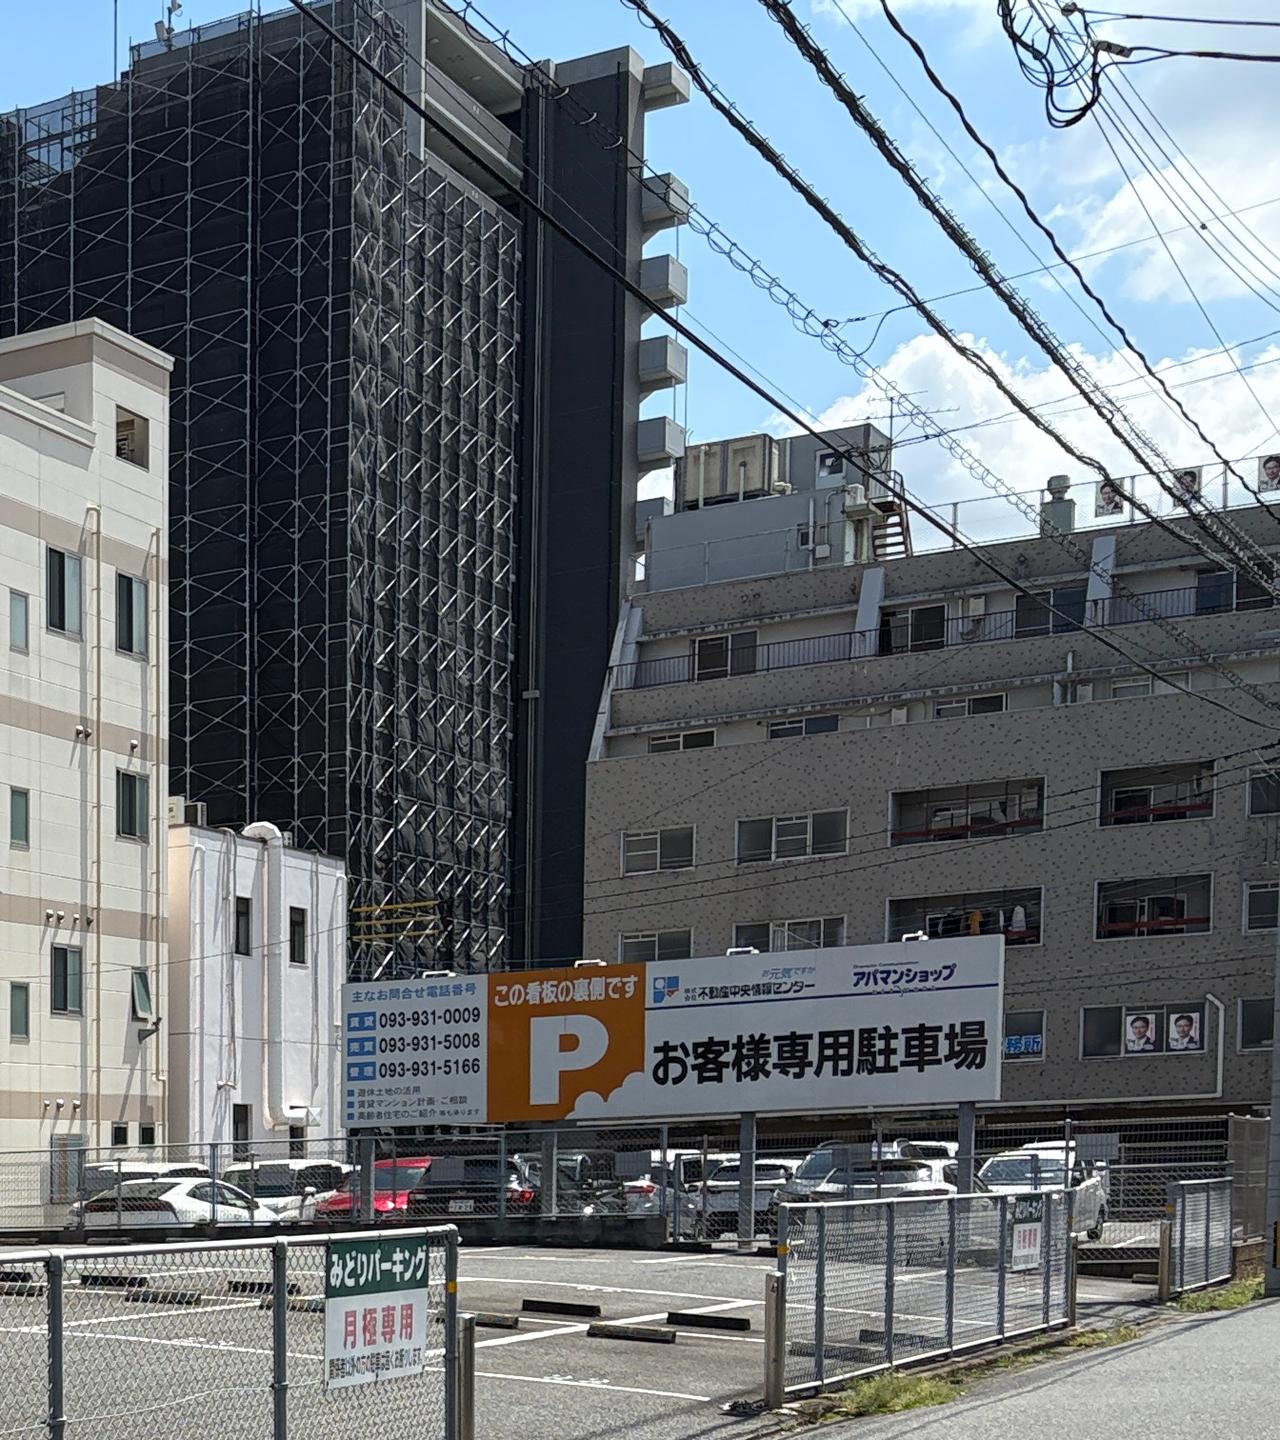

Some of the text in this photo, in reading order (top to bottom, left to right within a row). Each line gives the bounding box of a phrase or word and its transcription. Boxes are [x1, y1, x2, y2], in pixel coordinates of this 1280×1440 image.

[852, 963, 957, 987] アパマンショップ
[351, 982, 478, 1003] 主なお問合せ電話番号
[494, 975, 638, 1007] この看板の裏側です
[697, 981, 815, 1001] 不動産中央情報センター
[379, 1006, 481, 1029] 093-931-0009
[379, 1032, 481, 1053] 093-931-5008
[653, 1019, 989, 1087] お客様専用駐車場
[378, 1059, 481, 1079] 093-931-5166
[529, 1014, 609, 1106] P
[357, 1086, 421, 1097] 遊休土地の活用
[329, 1244, 427, 1289] みどりパーキング
[343, 1303, 414, 1350] 月極専用
